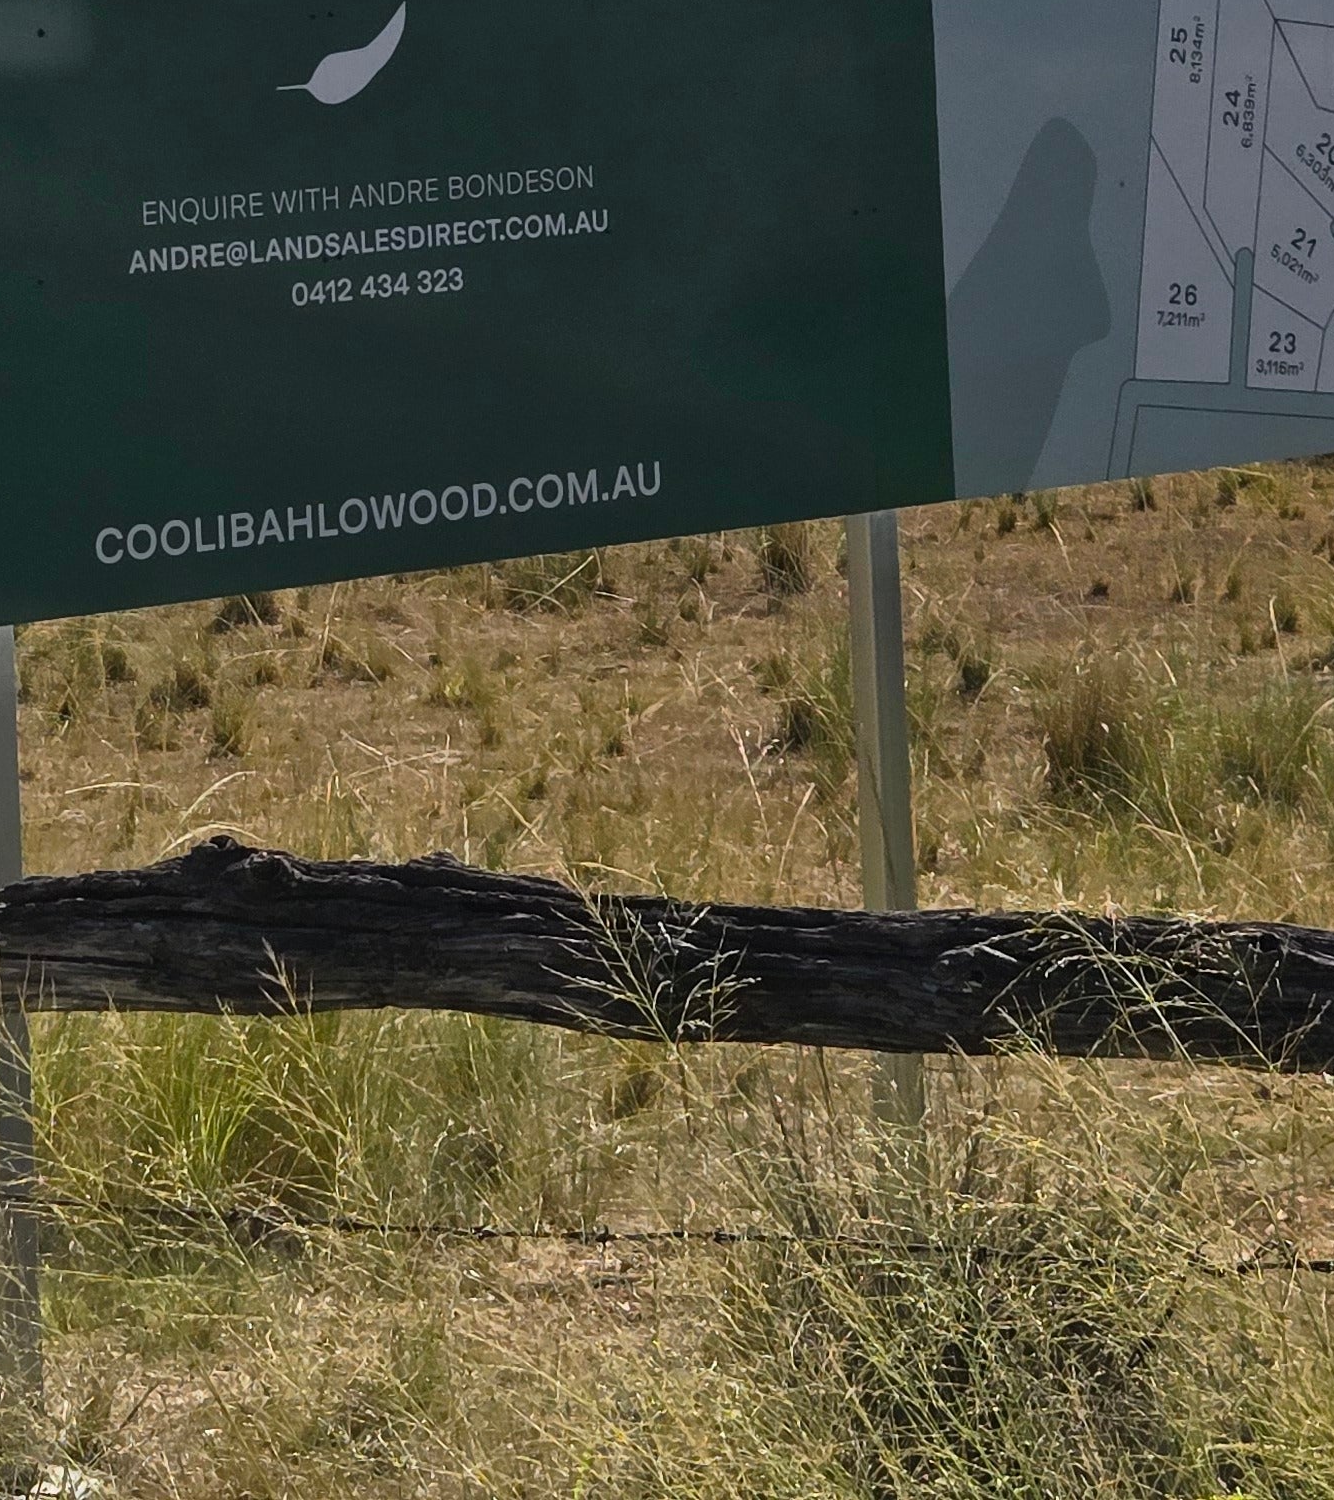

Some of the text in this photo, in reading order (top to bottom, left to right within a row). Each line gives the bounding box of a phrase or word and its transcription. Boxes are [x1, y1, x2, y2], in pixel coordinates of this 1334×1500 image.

[1169, 27, 1188, 64] 25
[1223, 89, 1241, 127] 24
[143, 166, 593, 225] ENQUIRE WITH ANDRE BONDESON
[128, 208, 610, 275] ANDRE@LANDSALESDIRECT.COM.AU
[1290, 228, 1317, 257] 21
[292, 267, 463, 306] 0412 434 323
[1169, 283, 1197, 305] 26
[1269, 331, 1296, 354] 23
[95, 460, 663, 565] COOLIBAHLOWOOD.COM.AU
